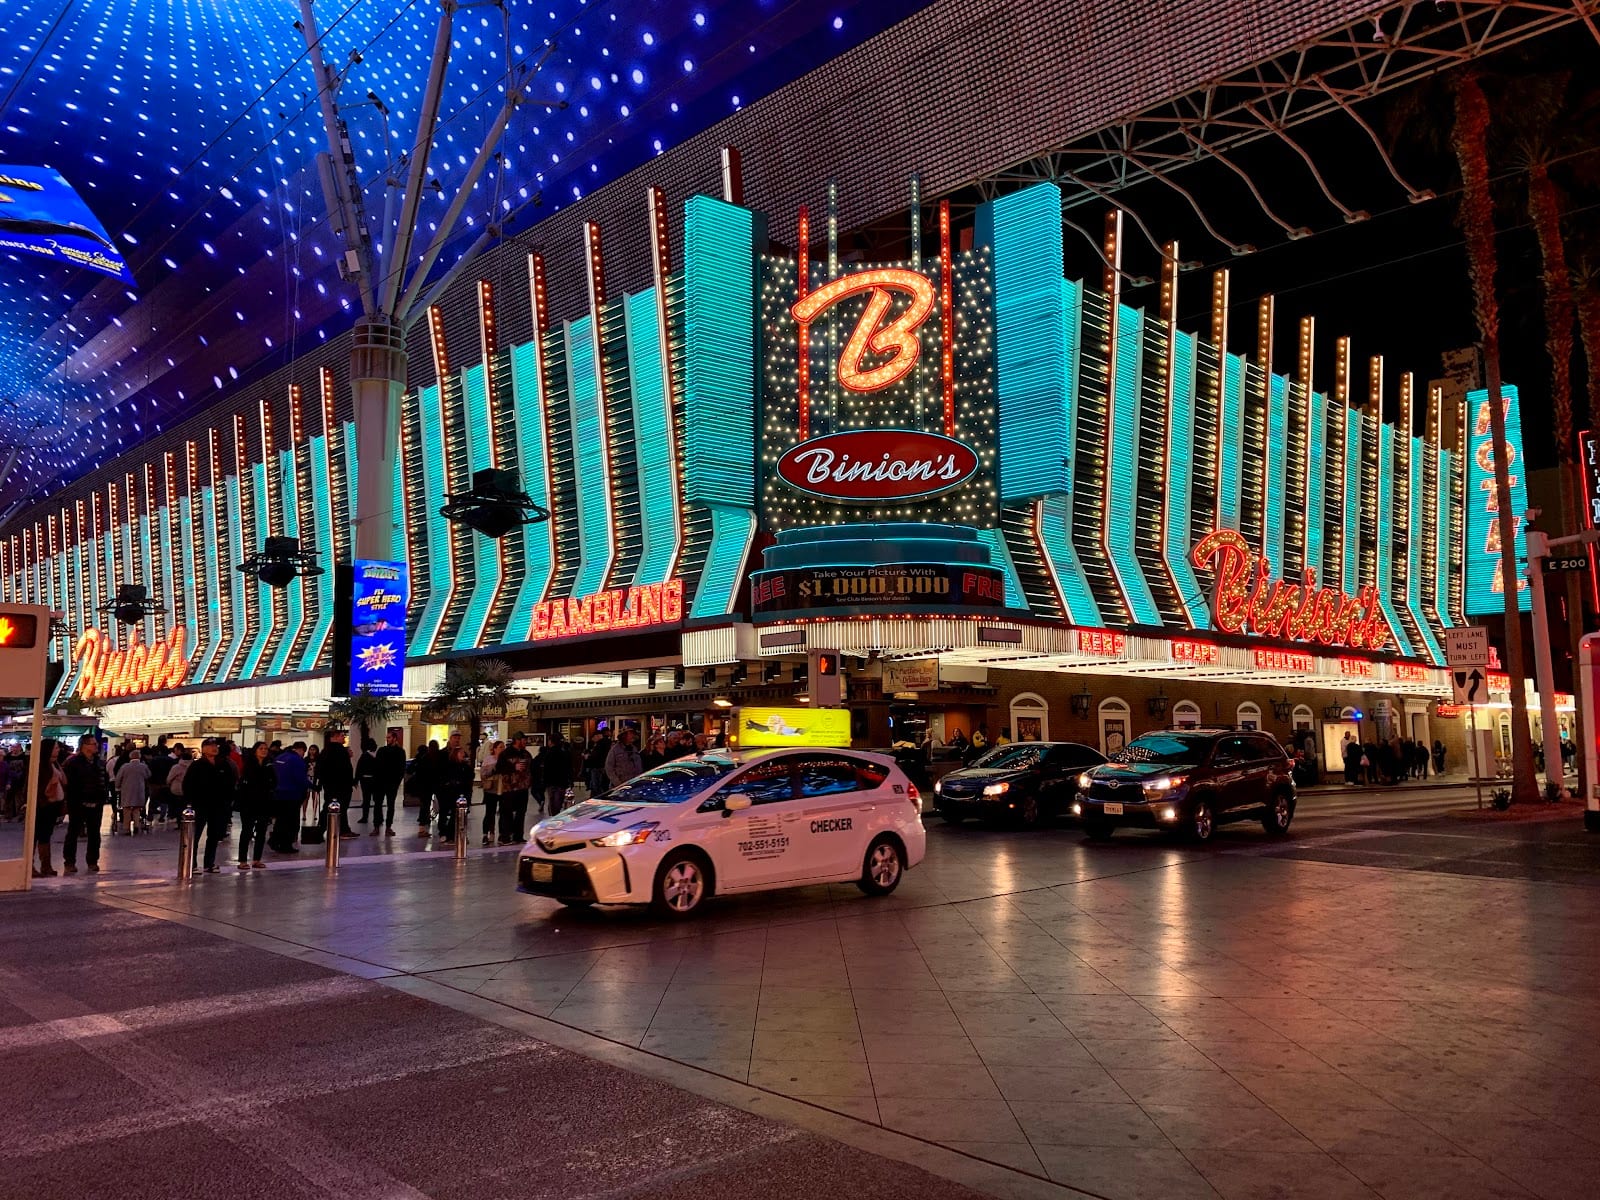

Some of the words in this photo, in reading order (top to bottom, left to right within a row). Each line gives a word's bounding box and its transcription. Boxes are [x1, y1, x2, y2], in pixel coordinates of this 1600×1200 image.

[790, 268, 935, 391] B
[794, 448, 961, 484] Binion's
[1549, 561, 1557, 570] E
[1561, 558, 1586, 569] 200
[813, 571, 837, 579] Take
[839, 570, 865, 578] Your
[867, 569, 907, 577] Picture
[909, 568, 936, 576] With
[798, 576, 950, 597] $1,000,000
[1194, 529, 1390, 650] Binion's
[382, 595, 402, 603] HERO
[532, 578, 683, 641] GAMBLING
[1080, 631, 1125, 654] KENO
[1449, 631, 1465, 639] LEFT
[1467, 631, 1484, 639] LANE
[1174, 641, 1218, 662] CRAPS
[1456, 641, 1478, 650] MUST
[73, 624, 188, 701] Binion's
[1256, 650, 1313, 672] ROULETTE
[1449, 653, 1467, 661] TURN
[1470, 653, 1486, 661] LEFT
[1342, 660, 1373, 676] SLOTS
[810, 817, 853, 833] CHECKER
[737, 836, 790, 852] 702-551-5151
